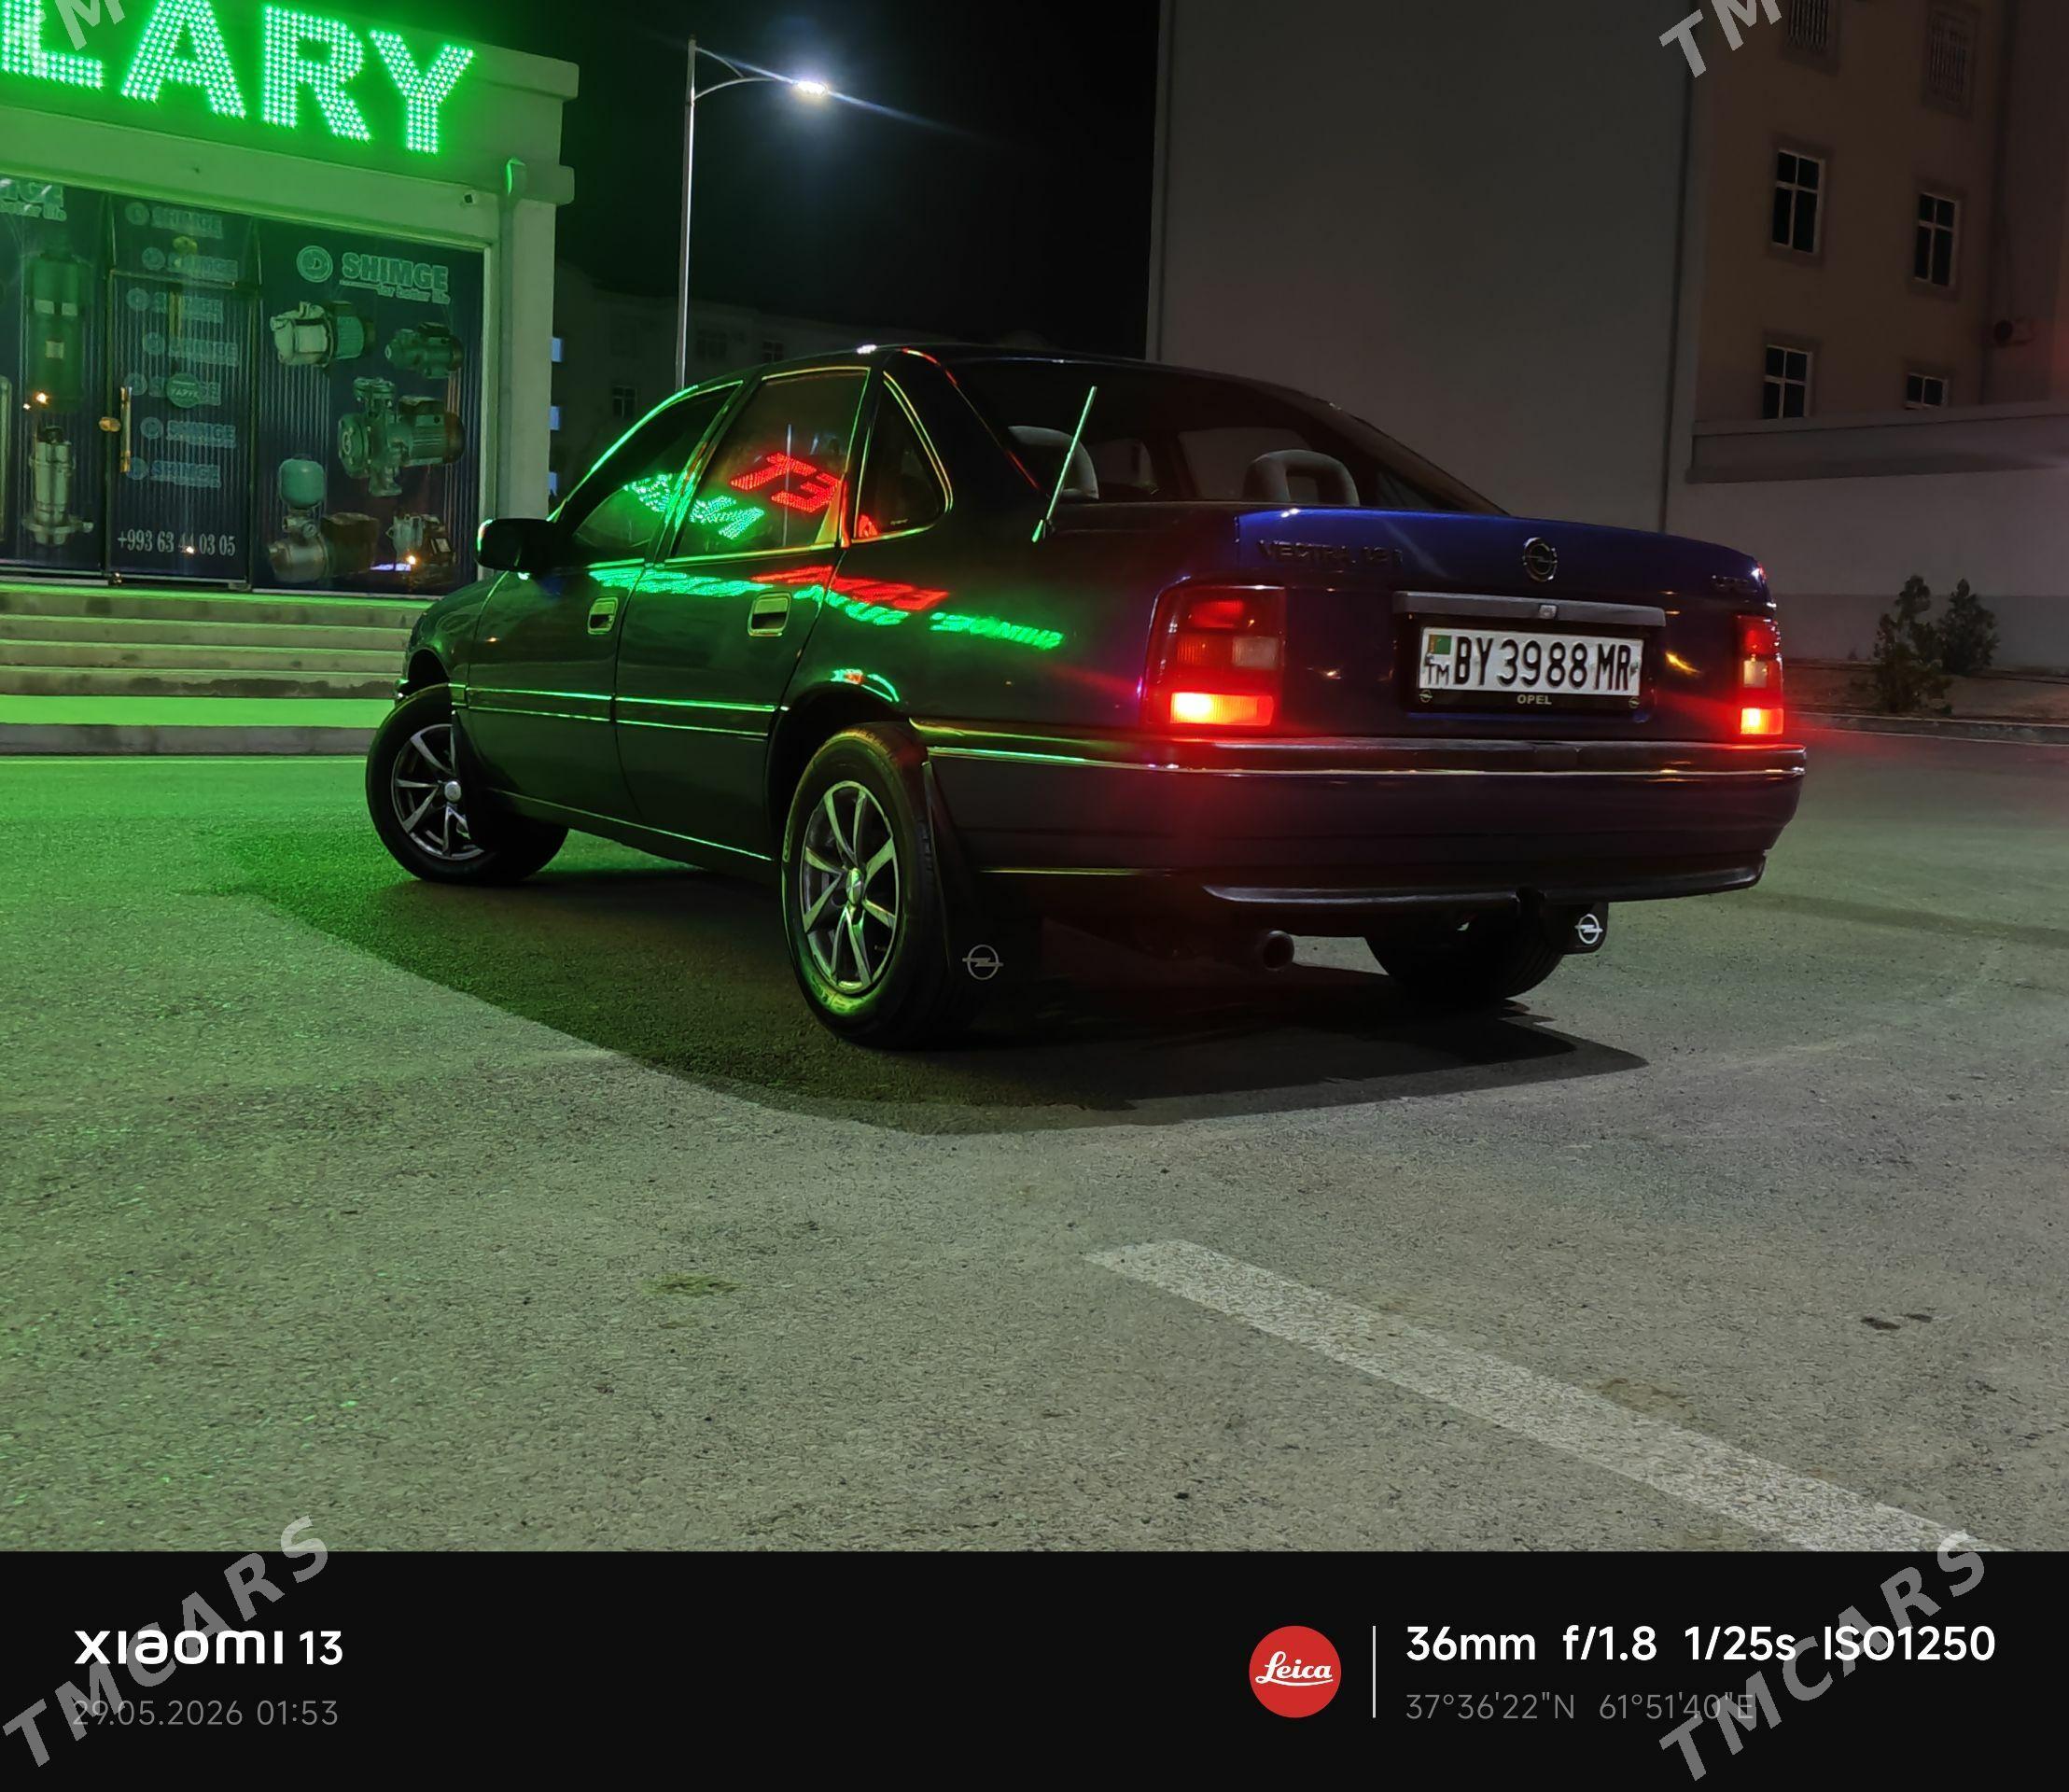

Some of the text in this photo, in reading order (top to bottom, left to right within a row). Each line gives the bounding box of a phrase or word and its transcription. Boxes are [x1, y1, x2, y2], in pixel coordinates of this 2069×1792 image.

[342, 251, 449, 291] SHIMGE
[118, 528, 153, 552] +993
[157, 530, 175, 553] 63
[199, 533, 216, 556] 03
[219, 534, 236, 556] 05
[1517, 693, 1552, 705] OPEL
